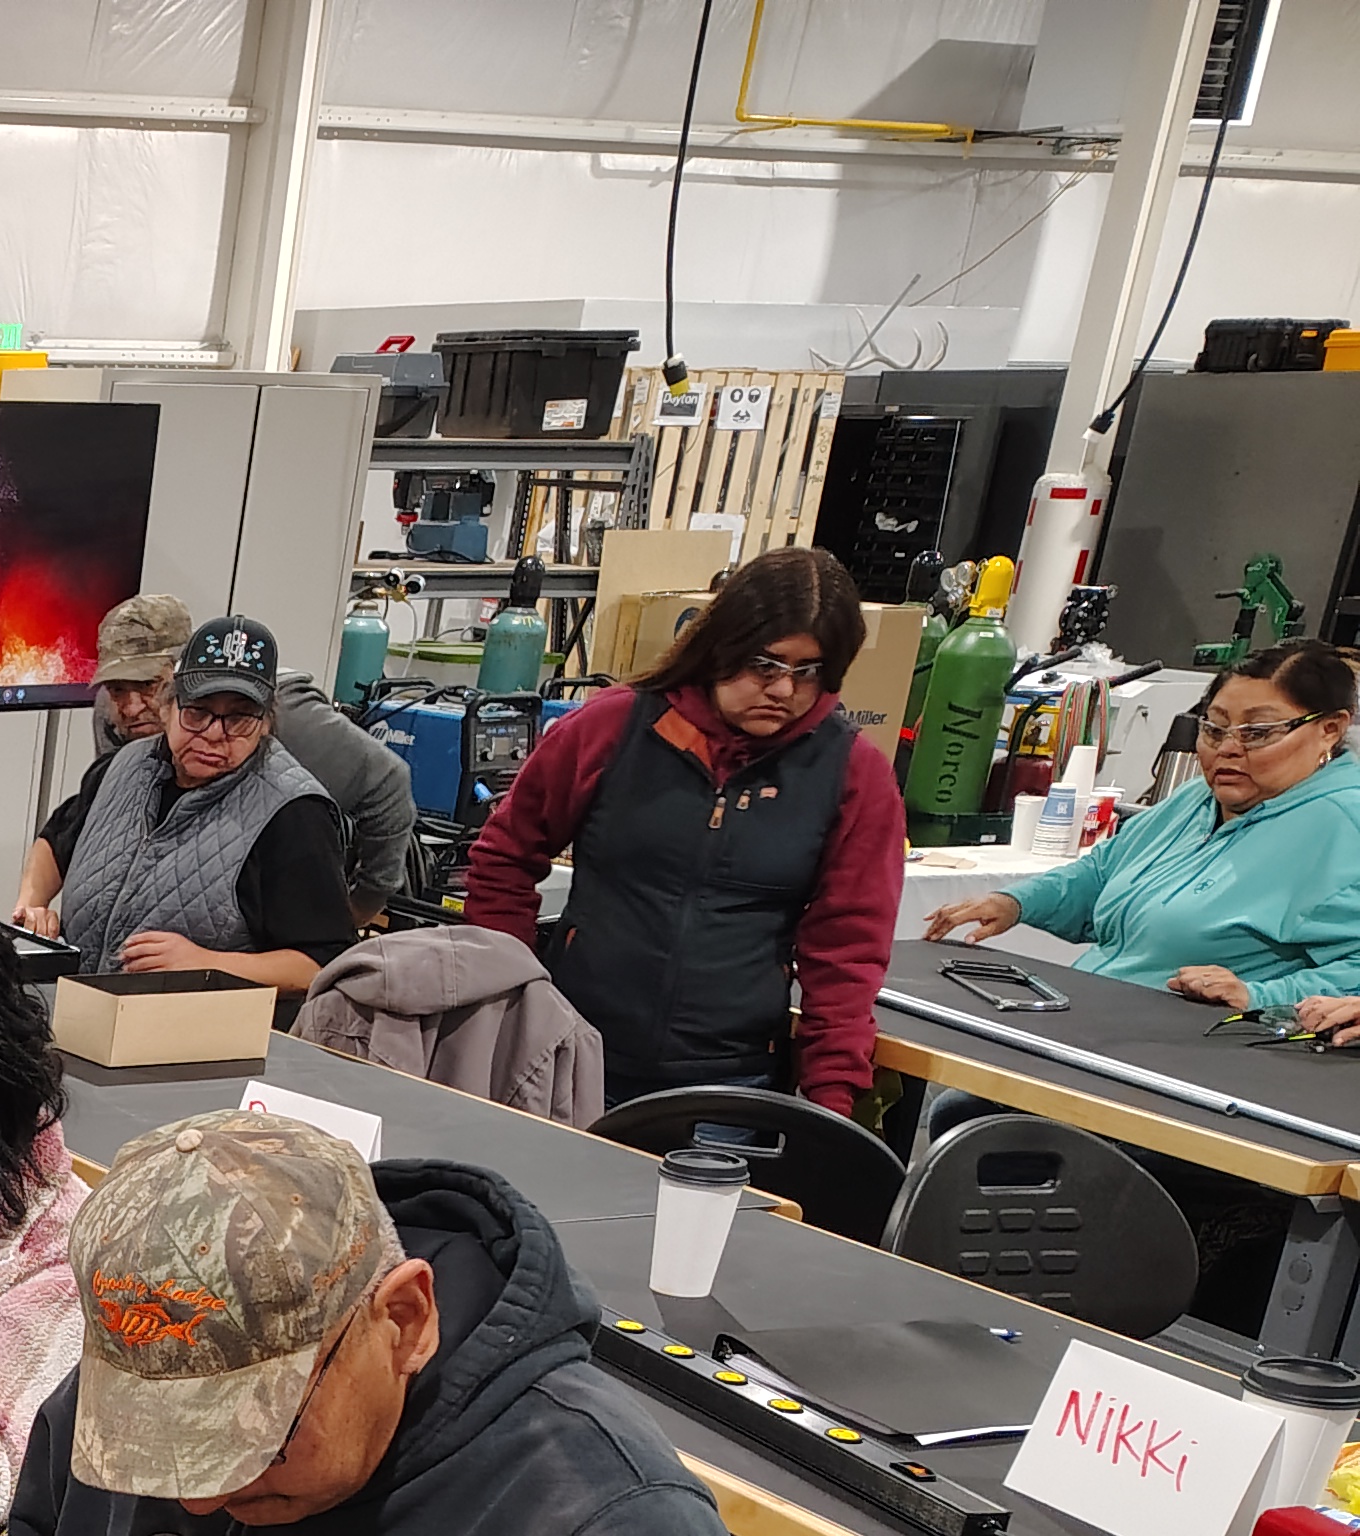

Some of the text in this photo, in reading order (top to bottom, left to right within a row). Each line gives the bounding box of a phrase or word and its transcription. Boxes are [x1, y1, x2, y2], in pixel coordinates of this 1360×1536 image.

[848, 709, 887, 726] Miller
[935, 701, 983, 805] Norco
[151, 1279, 227, 1312] Lodge
